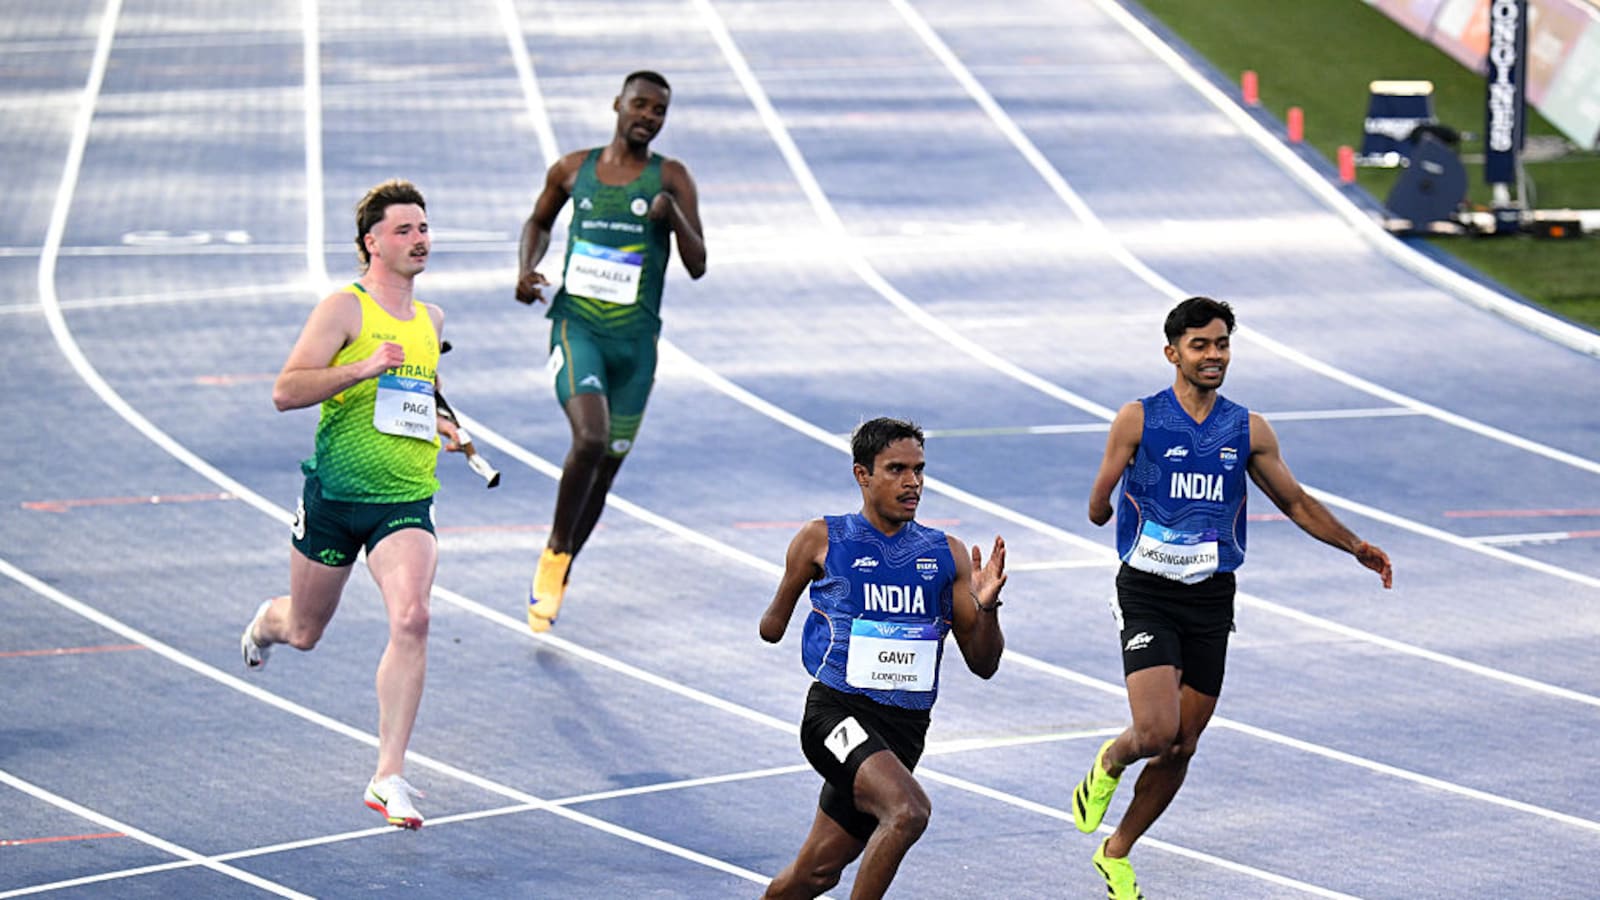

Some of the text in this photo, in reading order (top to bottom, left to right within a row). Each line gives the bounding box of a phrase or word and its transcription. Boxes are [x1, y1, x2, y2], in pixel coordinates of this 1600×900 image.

[1490, 0, 1518, 151] ONGINES
[1170, 472, 1224, 502] INDIA
[863, 583, 926, 614] INDIA
[878, 651, 916, 665] GAVIT
[834, 726, 849, 748] 7
